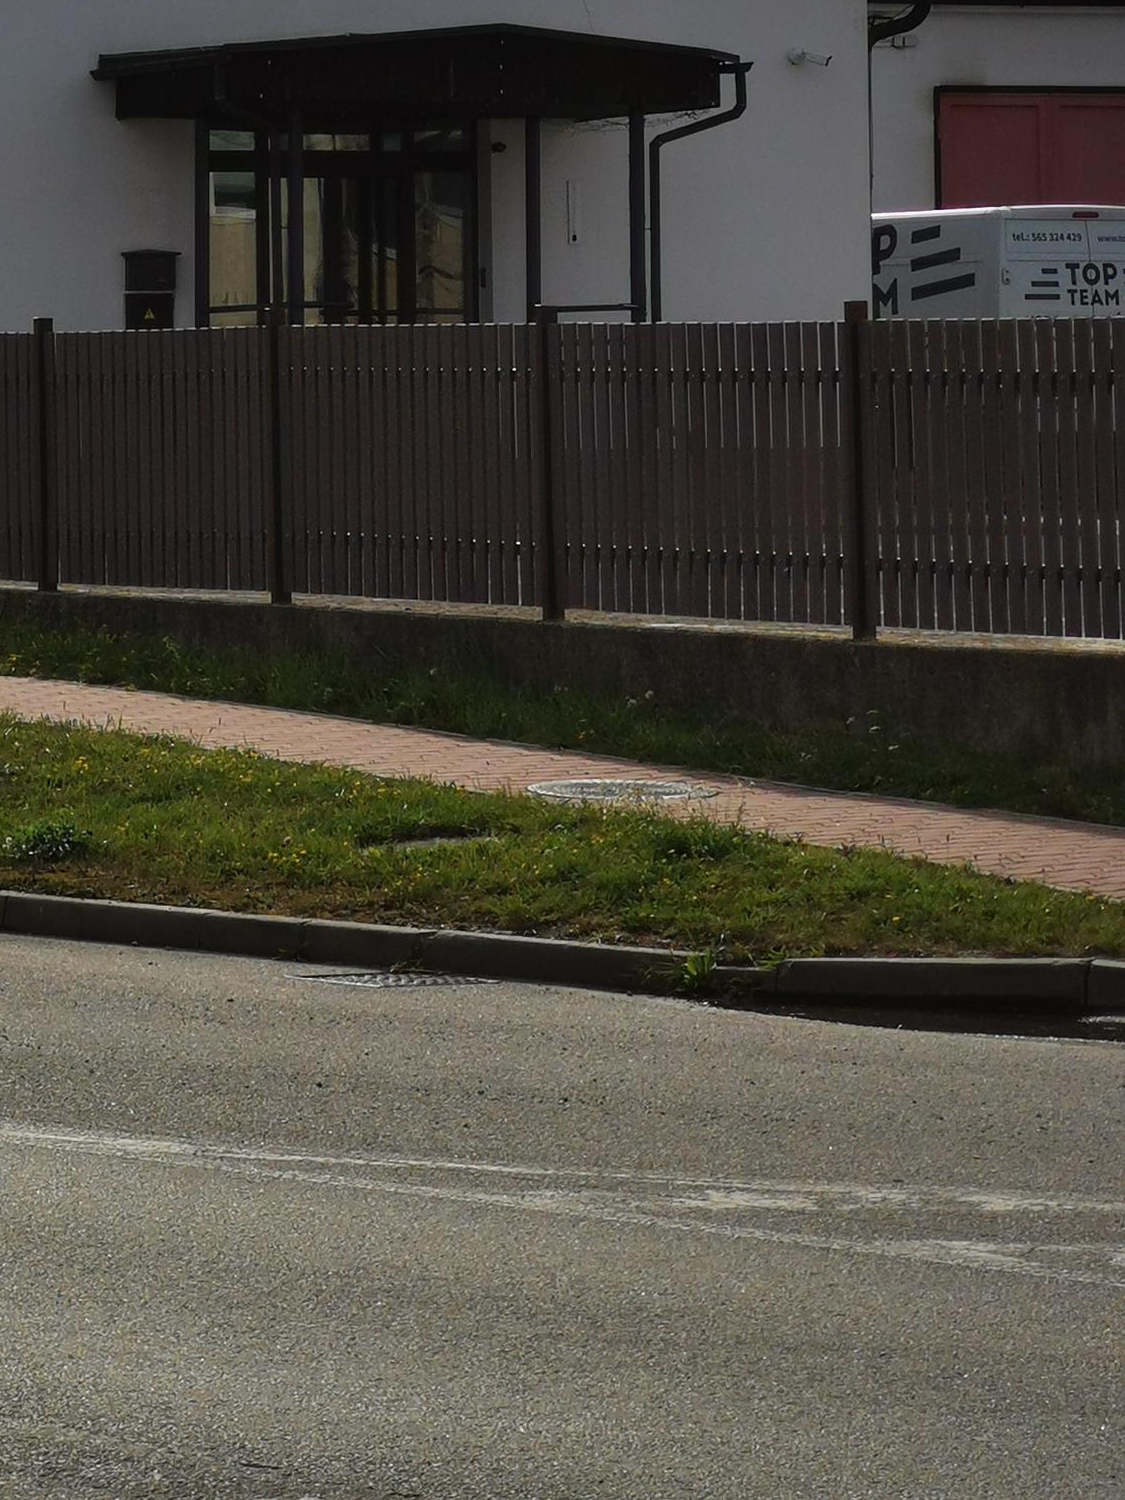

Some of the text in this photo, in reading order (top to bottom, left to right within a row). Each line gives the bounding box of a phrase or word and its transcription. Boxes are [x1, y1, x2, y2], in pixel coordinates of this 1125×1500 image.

[1031, 233, 1047, 242] 565
[1049, 233, 1065, 242] 324
[1066, 233, 1082, 243] 429
[1065, 263, 1117, 286] TOP
[1067, 289, 1119, 306] TEAM
